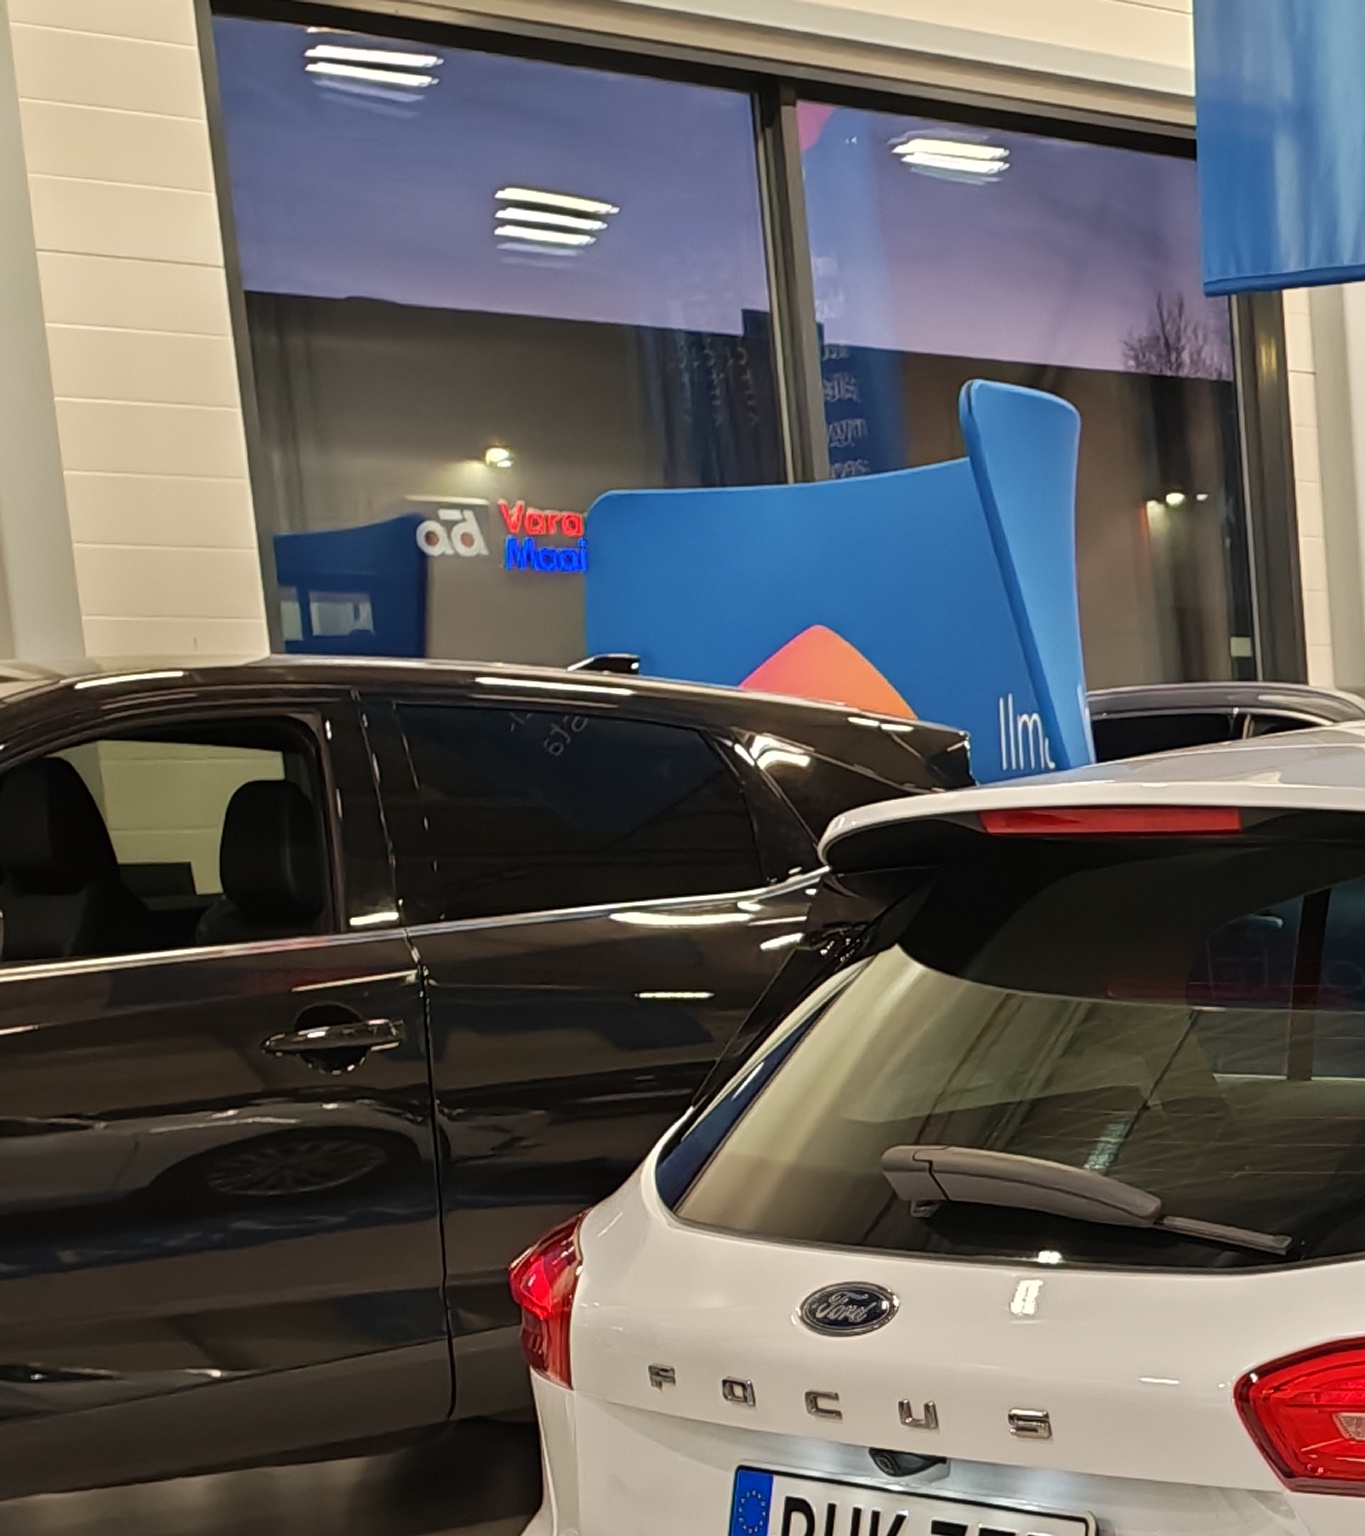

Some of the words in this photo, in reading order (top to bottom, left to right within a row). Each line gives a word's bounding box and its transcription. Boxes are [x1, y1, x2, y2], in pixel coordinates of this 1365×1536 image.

[498, 499, 588, 538] Vara
[999, 692, 1056, 771] Ilm
[647, 1362, 1053, 1440] FOCUS
